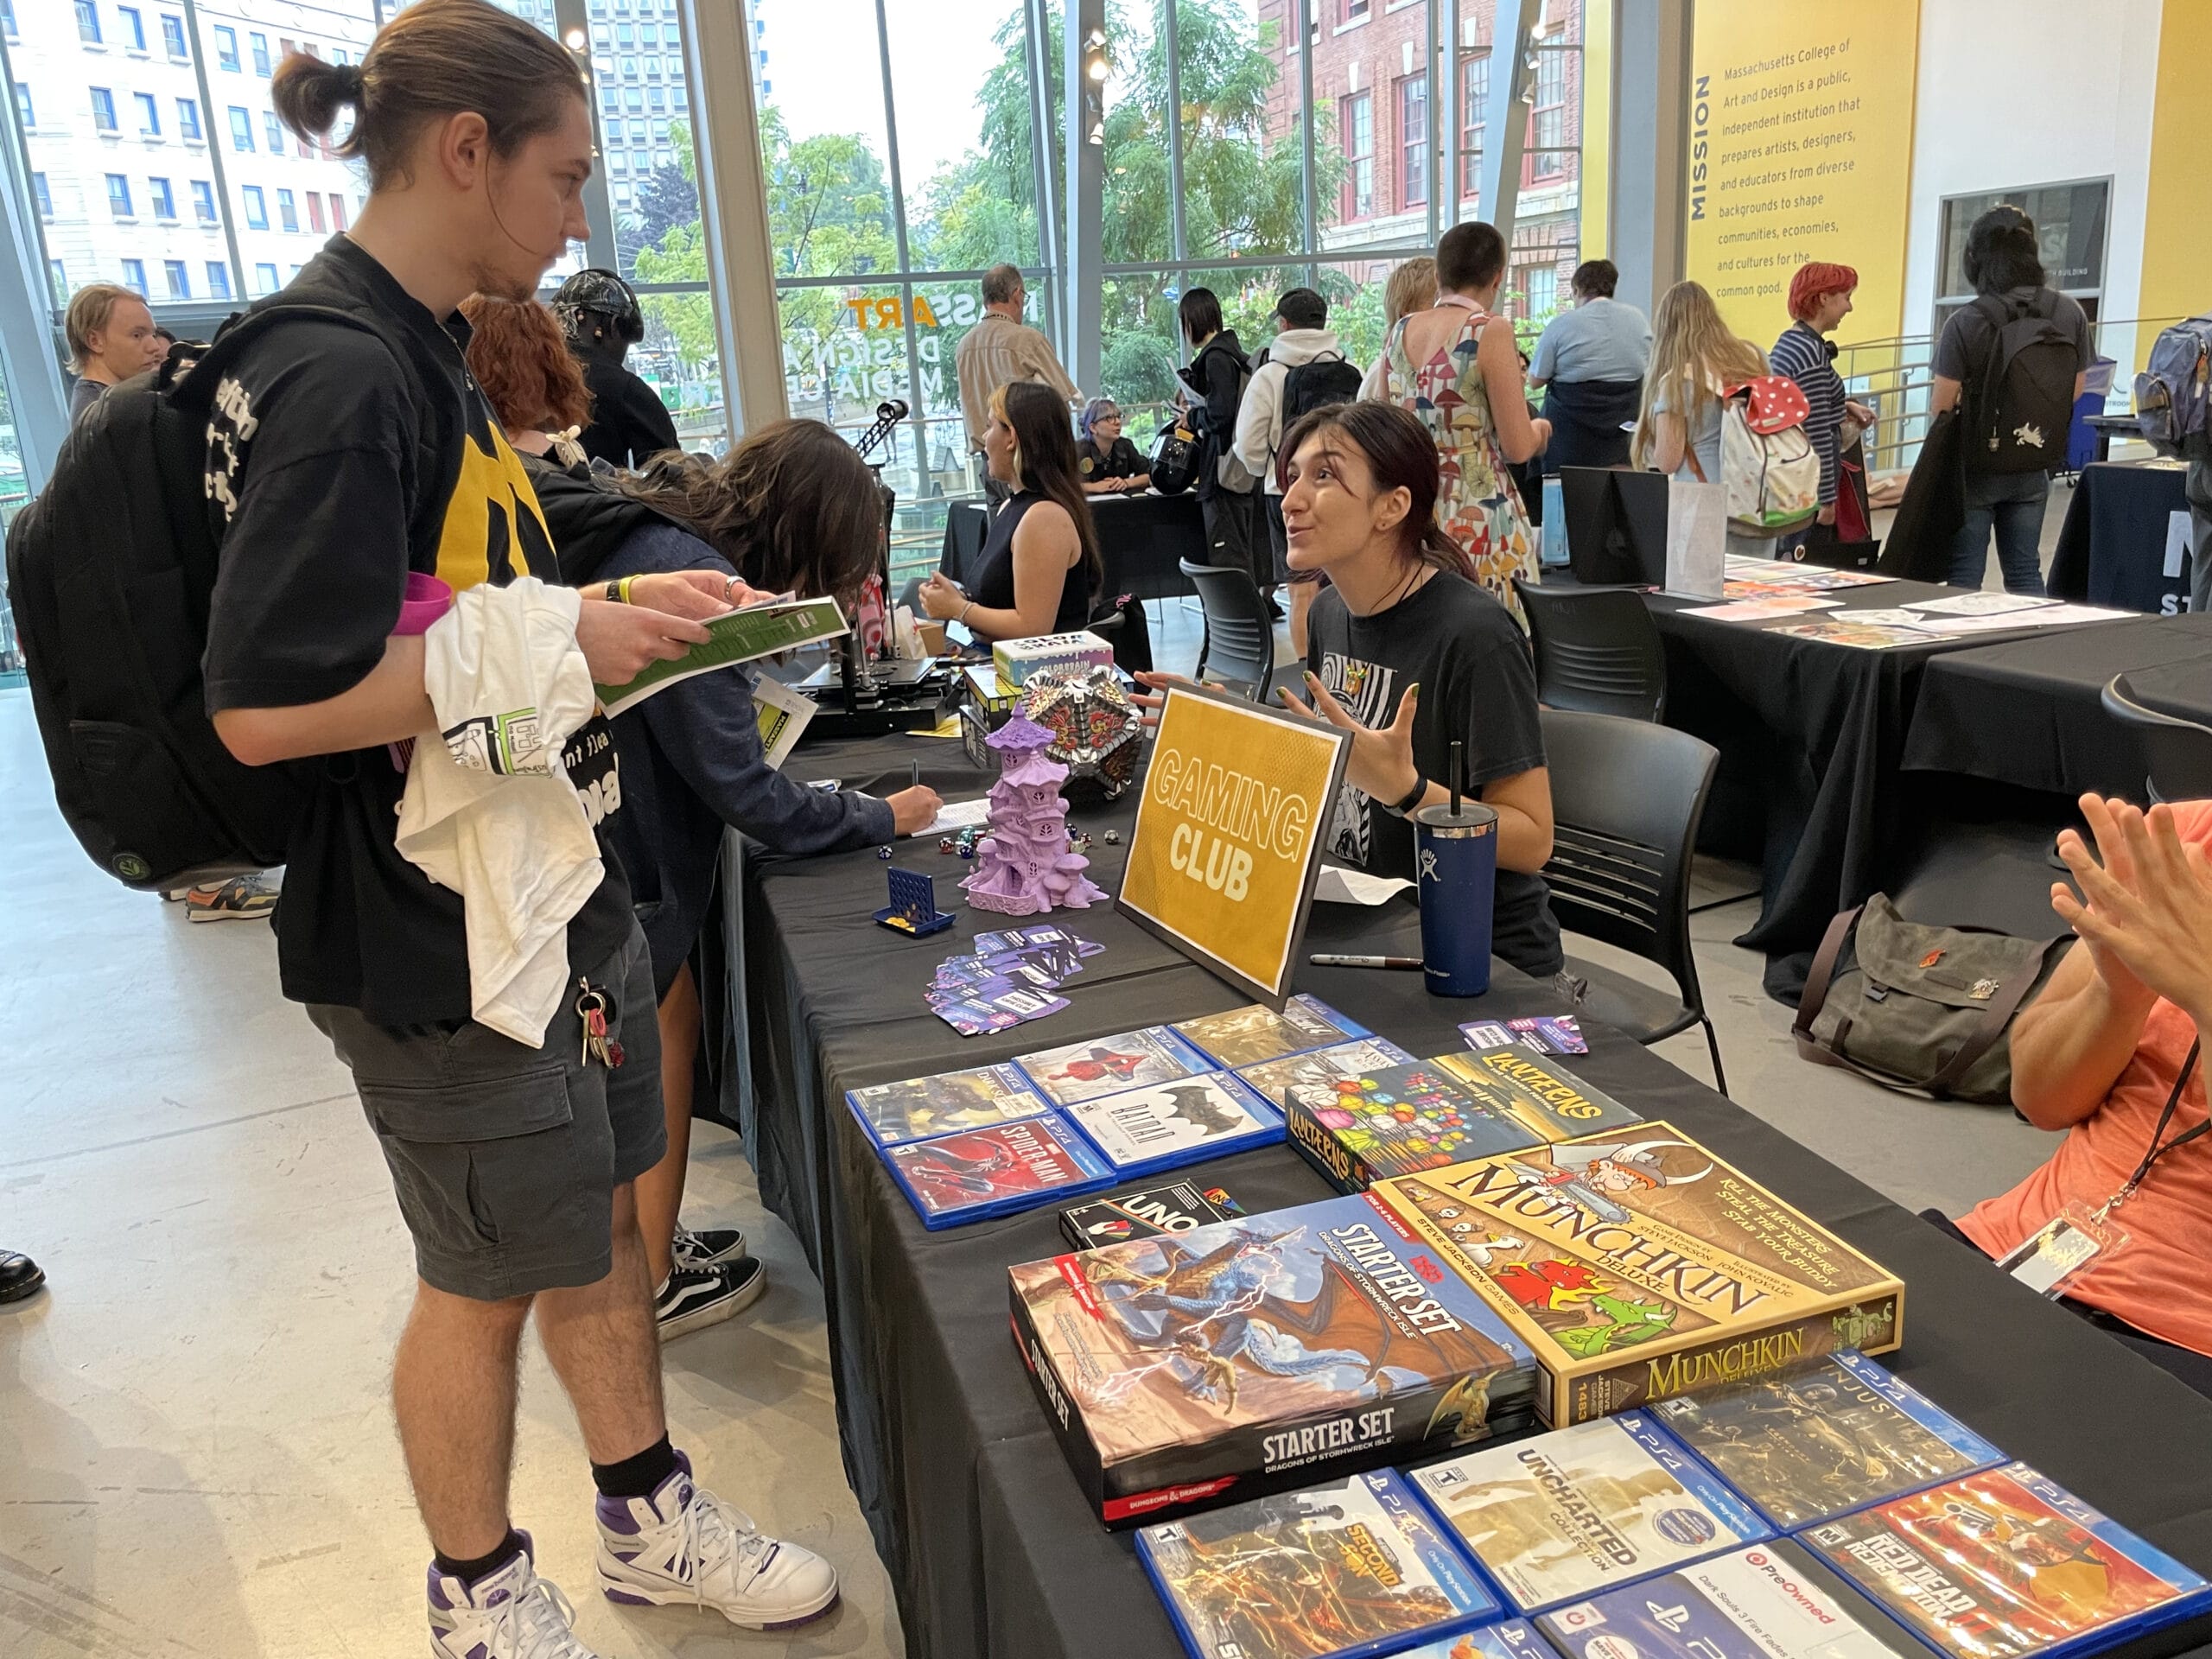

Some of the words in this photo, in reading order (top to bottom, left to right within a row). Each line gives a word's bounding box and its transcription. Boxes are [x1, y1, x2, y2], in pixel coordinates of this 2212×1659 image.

[1725, 54, 1796, 80] Massachusetts
[1798, 44, 1836, 63] College
[1840, 38, 1850, 53] of
[1723, 96, 1738, 109] Art
[1741, 90, 1758, 105] and
[1761, 83, 1794, 100] Design
[1796, 79, 1805, 92] is
[1808, 79, 1814, 91] a
[1816, 70, 1851, 91] public,
[1722, 114, 1780, 137] independent
[1783, 103, 1835, 123] institution
[1838, 97, 1860, 114] that
[1691, 75, 1710, 221] MISSION
[1721, 146, 1763, 166] prepares
[1764, 138, 1800, 156] artists,
[1802, 130, 1856, 151] designers,
[1720, 177, 1737, 191] and
[1739, 169, 1787, 188] educators
[1789, 165, 1814, 181] from
[1816, 160, 1854, 176] diverse
[1719, 199, 1778, 218] backgrounds
[1781, 198, 1791, 210] to
[1794, 192, 1824, 209] shape
[1718, 226, 1780, 245] communities,
[1782, 219, 1839, 238] economies,
[1717, 258, 1733, 271] and
[1736, 254, 1774, 270] cultures
[1777, 252, 1791, 265] for
[1794, 251, 1810, 264] the
[1716, 284, 1754, 298] common
[1757, 282, 1783, 298] good.
[1154, 748, 1308, 863] GAMING
[1170, 823, 1254, 902] CLUB
[1003, 1071, 1021, 1088] PS4
[1221, 1080, 1244, 1098] PS4
[1482, 1052, 1603, 1119] LANTERNS
[1051, 1125, 1071, 1145] PS4
[1112, 1103, 1175, 1144] BATMAN
[1288, 1106, 1349, 1180] LANTERNS
[1000, 1124, 1069, 1183] SPIDER-MAN
[1122, 1194, 1199, 1234] UNO
[1209, 1192, 1233, 1206] UNO
[1365, 1194, 1378, 1208] FOR
[1382, 1211, 1410, 1238] PLAYERS
[1719, 1178, 1746, 1195] KILL
[1746, 1194, 1771, 1211] THE
[1766, 1210, 1833, 1255] MONSTERS
[1445, 1162, 1771, 1316] MUNCHKIN
[1637, 1225, 1665, 1242] STEVE
[1662, 1236, 1713, 1262] JACKSON
[1715, 1190, 1751, 1215] STEAL
[1753, 1215, 1780, 1232] THE
[1776, 1230, 1840, 1275] TREASURE
[1722, 1210, 1757, 1232] STAB
[1756, 1231, 1793, 1262] YOUR
[1789, 1257, 1838, 1288] BUDDY
[1319, 1230, 1349, 1264] DRAGONS
[1345, 1262, 1358, 1274] OF
[1352, 1270, 1399, 1326] STORMWRECK
[1395, 1318, 1419, 1340] ISLE
[1332, 1223, 1427, 1304] STARTER
[1399, 1298, 1464, 1337] SET
[1417, 1217, 1444, 1243] STEVE
[1443, 1242, 1487, 1283] JACKSON
[1484, 1283, 1521, 1315] GAMES
[1595, 1255, 1669, 1294] DELUXE
[1716, 1262, 1748, 1278] JOHN
[1745, 1274, 1795, 1299] KOVALIC
[1645, 1327, 1804, 1400] MUNCHKIN
[1031, 1338, 1057, 1409] STARTER
[1056, 1394, 1070, 1433] SET
[1578, 1382, 1588, 1421] 1483
[1859, 1368, 1906, 1401] PS4
[1262, 1417, 1354, 1464] STARTER
[1357, 1407, 1395, 1441] SET
[1265, 1457, 1305, 1474] DRAGONS
[1305, 1454, 1318, 1465] OF
[1318, 1442, 1374, 1462] STORMWRECK
[1373, 1436, 1395, 1449] ISLE
[1639, 1433, 1683, 1472] PS4
[1129, 1495, 1168, 1510] DUNGEONS
[1168, 1491, 1179, 1503] &
[1179, 1484, 1215, 1499] DRAGONS
[1517, 1449, 1637, 1566] UNCHARTED
[2034, 1484, 2090, 1521] PS4
[1345, 1523, 1402, 1586] SECOND
[1549, 1512, 1609, 1572] COLLECTION
[1818, 1528, 1842, 1543] M
[1339, 1543, 1371, 1578] SON
[1427, 1550, 1439, 1563] Only
[1438, 1561, 1446, 1574] On
[1442, 1571, 1472, 1605] PlayStation
[1862, 1533, 1919, 1569] RED
[1904, 1564, 1978, 1613] DEAD
[1761, 1565, 1837, 1624] PreOwned
[1698, 1574, 1719, 1593] Dark
[1716, 1591, 1741, 1613] Souls
[1744, 1618, 1764, 1635] Fire
[1761, 1633, 1789, 1659] Fades
